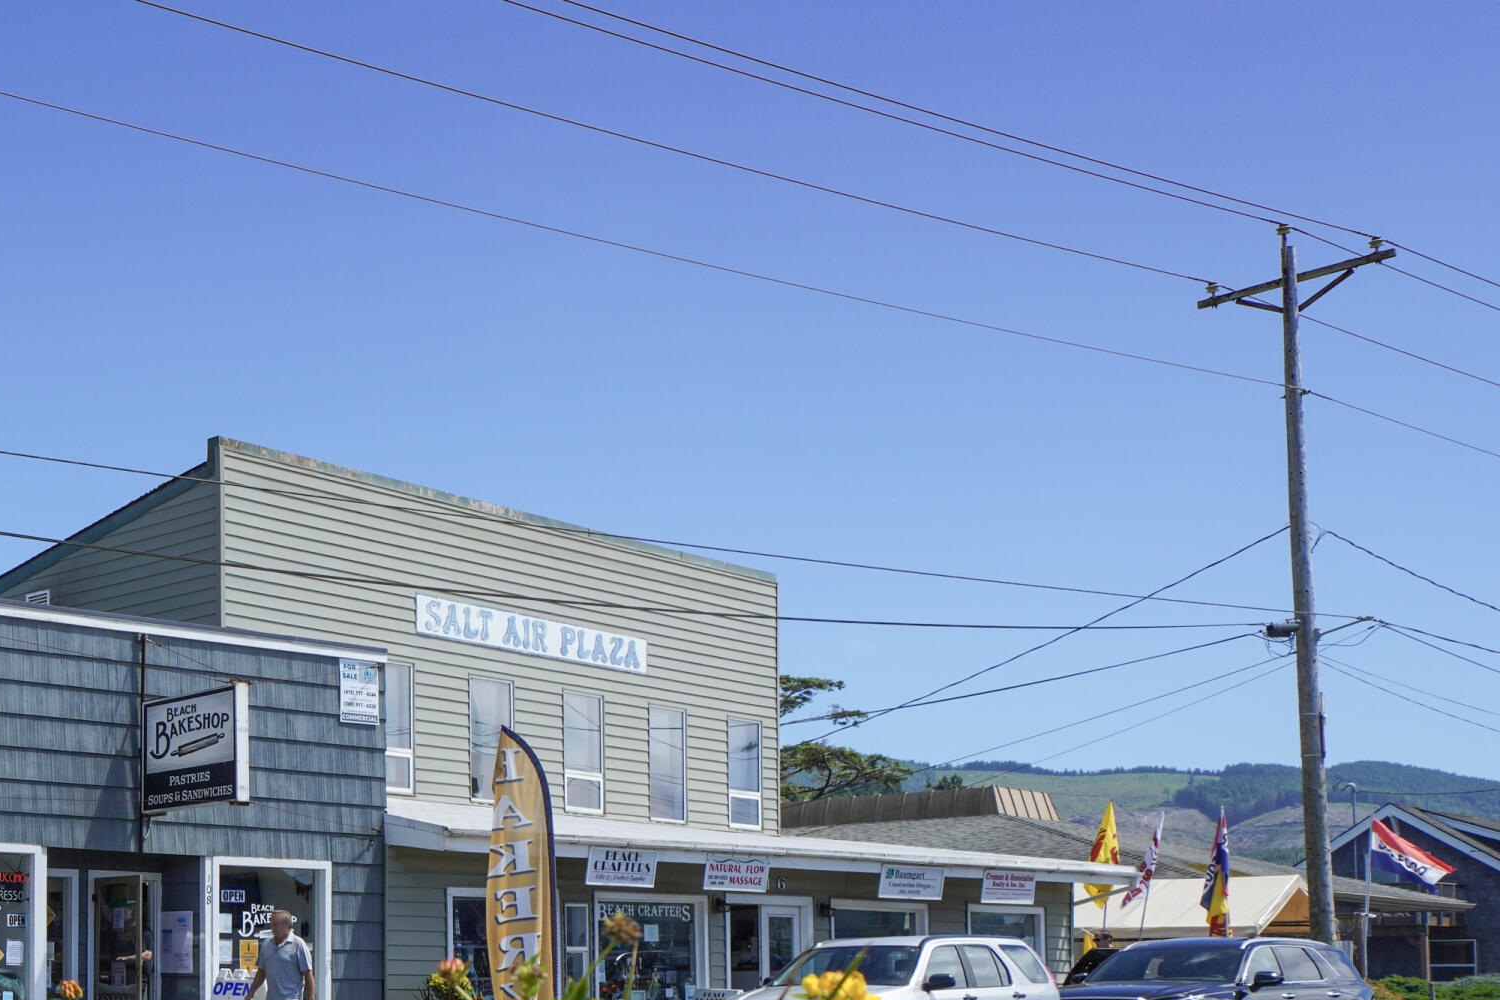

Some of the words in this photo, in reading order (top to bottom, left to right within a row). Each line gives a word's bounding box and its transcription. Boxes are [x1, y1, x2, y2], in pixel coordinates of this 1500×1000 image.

[425, 599, 493, 641] SALT
[503, 615, 548, 653] AIR
[559, 626, 641, 670] PLAZA
[342, 672, 357, 680] SALE
[166, 703, 197, 722] BEACH
[341, 713, 378, 722] COMMERCIAL
[149, 712, 230, 759] BAKESHOP
[169, 771, 211, 786] PASTRIES
[148, 792, 173, 806] SOUPS
[174, 791, 180, 801] &
[182, 784, 233, 801] SANDWICHES
[605, 851, 643, 862] BEACH
[594, 860, 651, 873] CRAFTERS
[709, 863, 741, 874] NATURAL
[746, 864, 765, 874] FLOW
[729, 876, 763, 886] MASSAGE
[894, 869, 925, 881] Baumgart
[222, 891, 244, 901] OPEN
[251, 903, 275, 914] BEACH
[598, 903, 635, 921] BEACH
[638, 904, 690, 922] CRAFTERS
[8, 915, 26, 926] OPEN
[238, 911, 298, 938] BAKEP
[213, 981, 250, 996] OPEN
